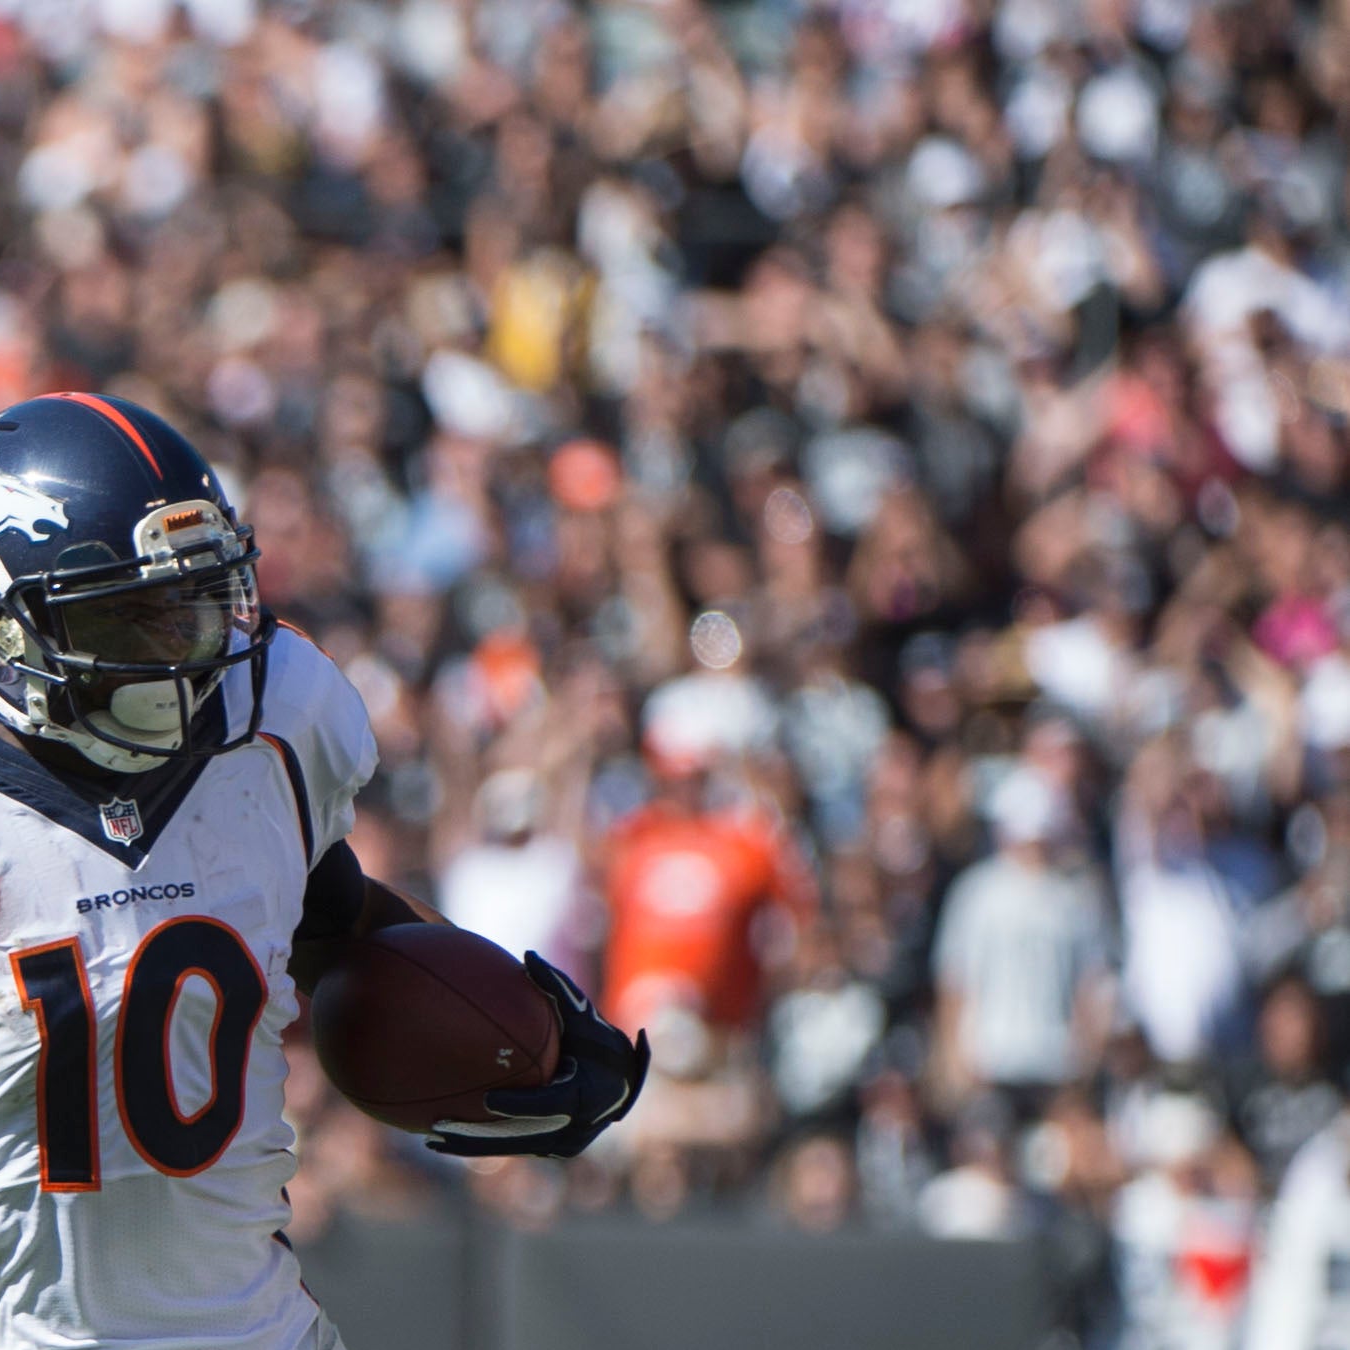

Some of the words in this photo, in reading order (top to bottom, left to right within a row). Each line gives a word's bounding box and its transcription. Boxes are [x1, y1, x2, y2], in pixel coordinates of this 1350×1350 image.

[109, 816, 138, 838] NFL
[75, 882, 196, 915] BRONCOS
[8, 914, 269, 1192] 10
